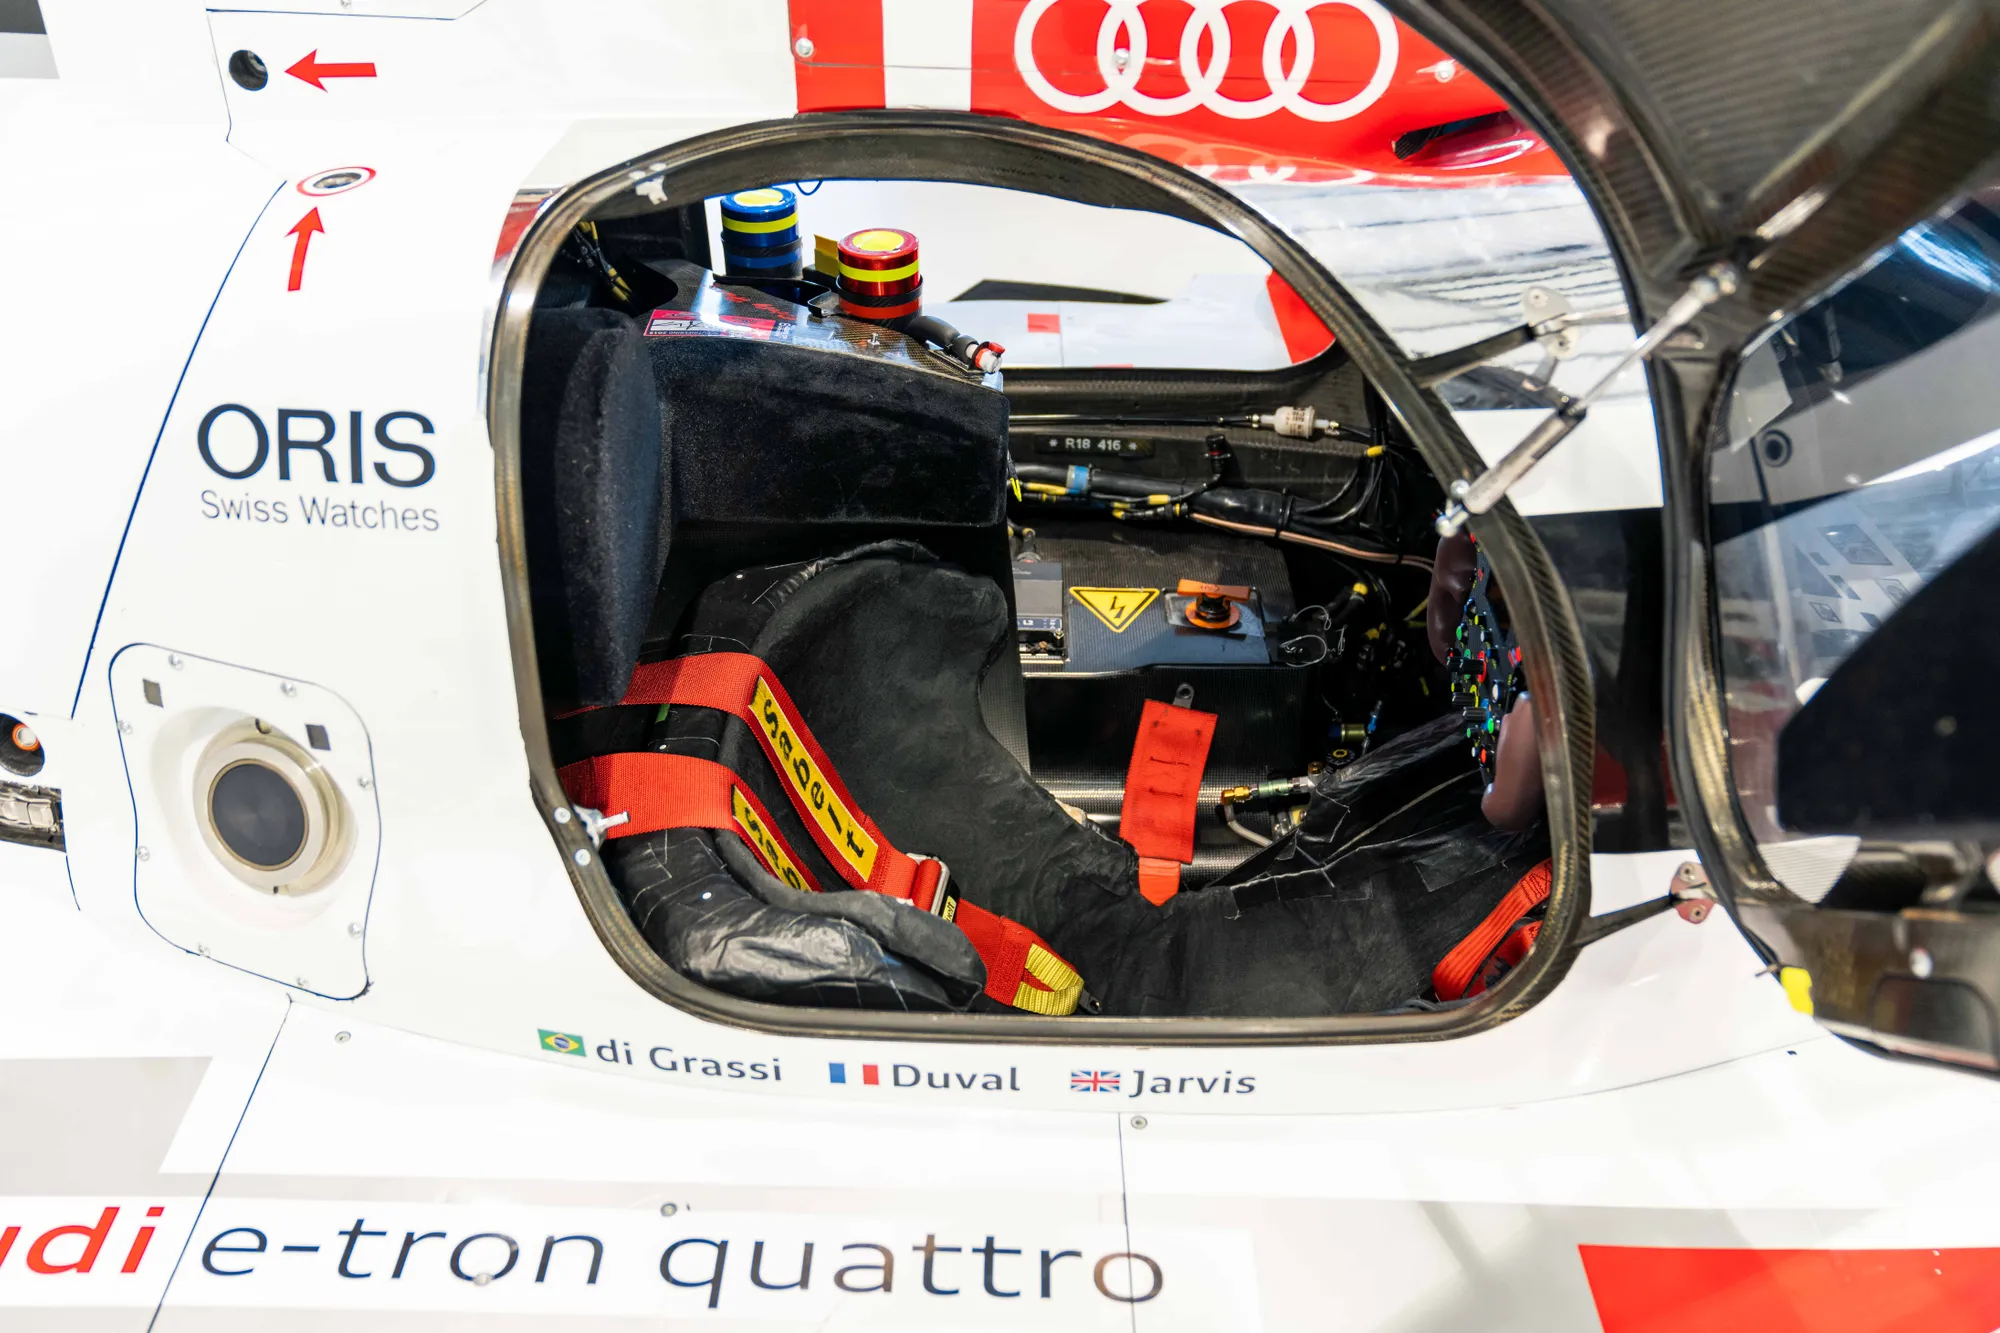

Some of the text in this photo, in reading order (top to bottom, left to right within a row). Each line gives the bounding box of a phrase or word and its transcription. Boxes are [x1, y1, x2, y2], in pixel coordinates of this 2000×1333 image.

[197, 403, 436, 489] ORIS
[1065, 437, 1121, 451] R18 416
[201, 489, 440, 531] Swiss Watches
[763, 698, 864, 859] sabelt
[744, 807, 809, 893] sab
[596, 1038, 782, 1082] di Grassi
[892, 1064, 1020, 1092] Duval
[1128, 1069, 1256, 1098] Jarvis
[201, 1218, 604, 1285] e-tron
[659, 1233, 1163, 1309] quattro
